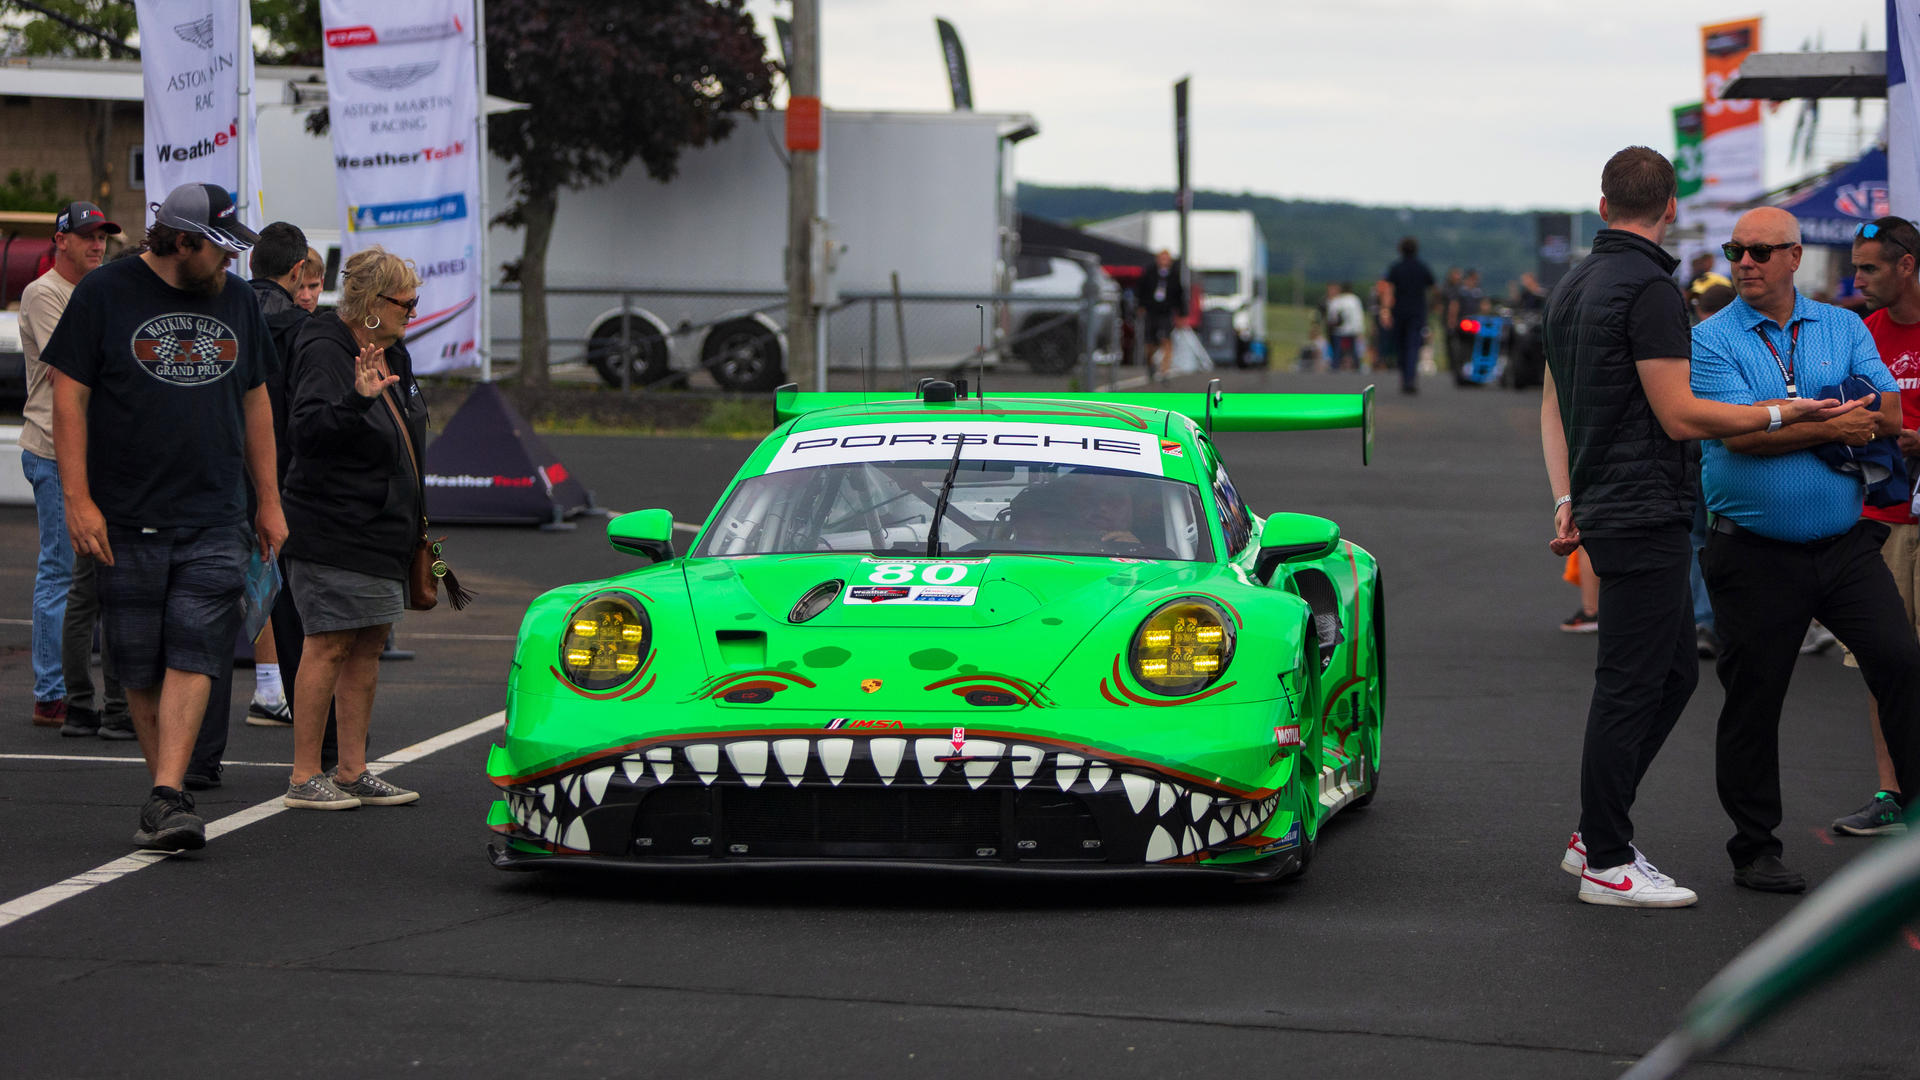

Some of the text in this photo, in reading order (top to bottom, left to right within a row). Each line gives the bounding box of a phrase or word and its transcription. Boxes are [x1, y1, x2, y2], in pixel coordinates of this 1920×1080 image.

[343, 96, 453, 119] ASTON MARTIN
[369, 116, 428, 134] RACING
[378, 201, 457, 224] MICHELIN
[145, 316, 225, 339] WATKINS GLEN
[155, 364, 222, 376] GRAND PRIX
[791, 433, 1142, 456] PORSCHE
[868, 563, 968, 585] 80
[848, 719, 904, 729] IMSA
[954, 728, 963, 743] TOW
[1277, 727, 1300, 745] MOTUL
